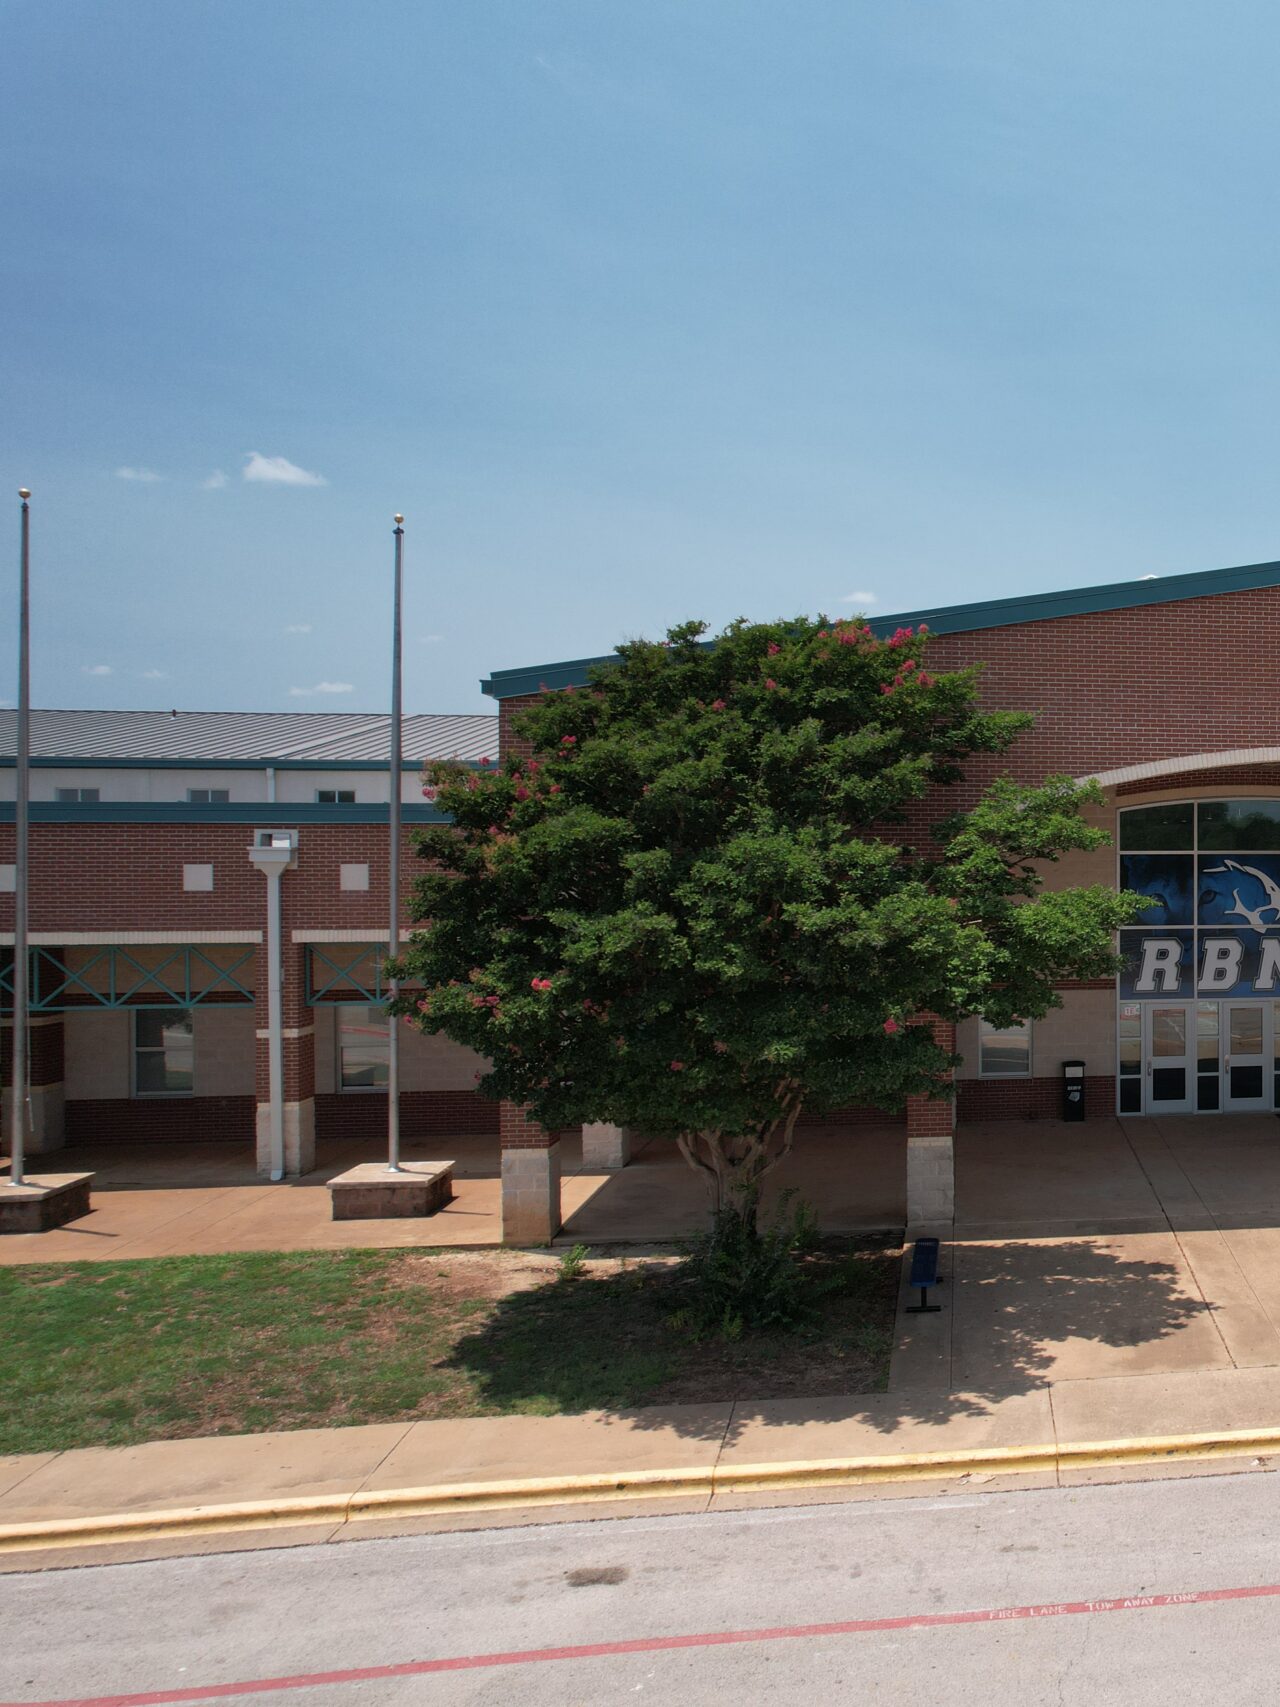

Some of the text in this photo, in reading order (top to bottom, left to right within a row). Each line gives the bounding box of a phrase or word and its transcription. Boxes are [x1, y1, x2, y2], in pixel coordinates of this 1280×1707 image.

[989, 1592, 1198, 1619] FIRE LANE TOW AWAY ZONE
